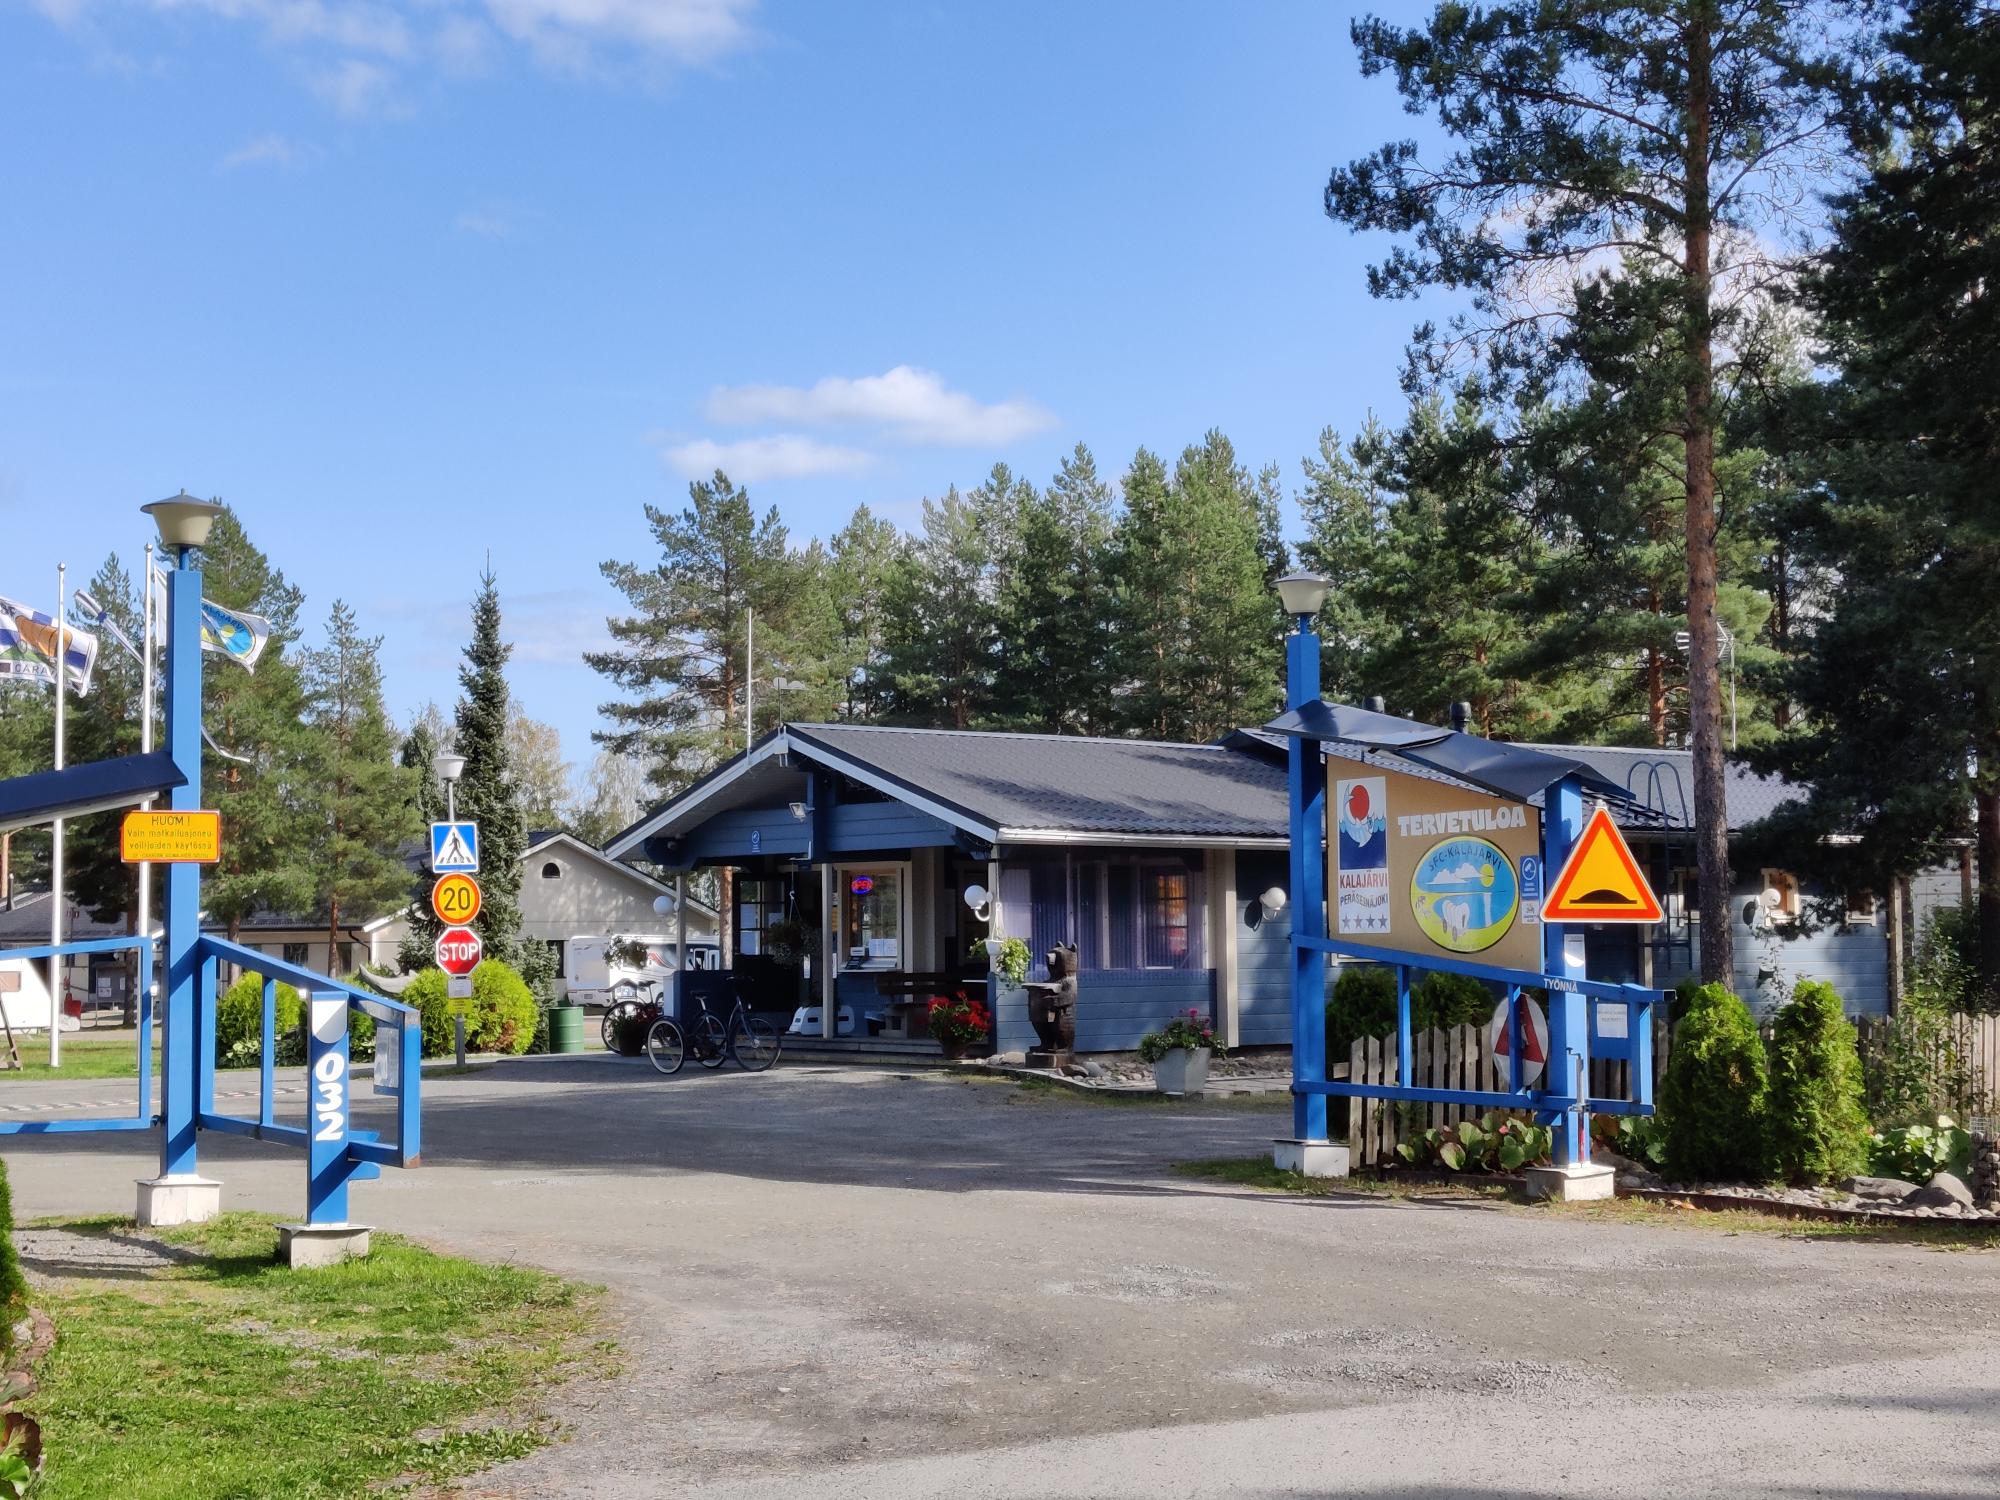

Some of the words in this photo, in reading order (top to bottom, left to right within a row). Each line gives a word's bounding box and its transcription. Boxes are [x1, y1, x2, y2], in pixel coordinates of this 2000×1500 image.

[1397, 805, 1527, 837] TERVETULOA
[127, 829, 145, 837] Vain
[1339, 869, 1388, 889] KALAJÄRVI
[443, 886, 471, 911] 20
[1339, 889, 1389, 908] PERÄSEINÄJOKI
[440, 942, 479, 962] STOP
[1543, 978, 1578, 993] TYÖNNÄ
[315, 1052, 345, 1142] 032
